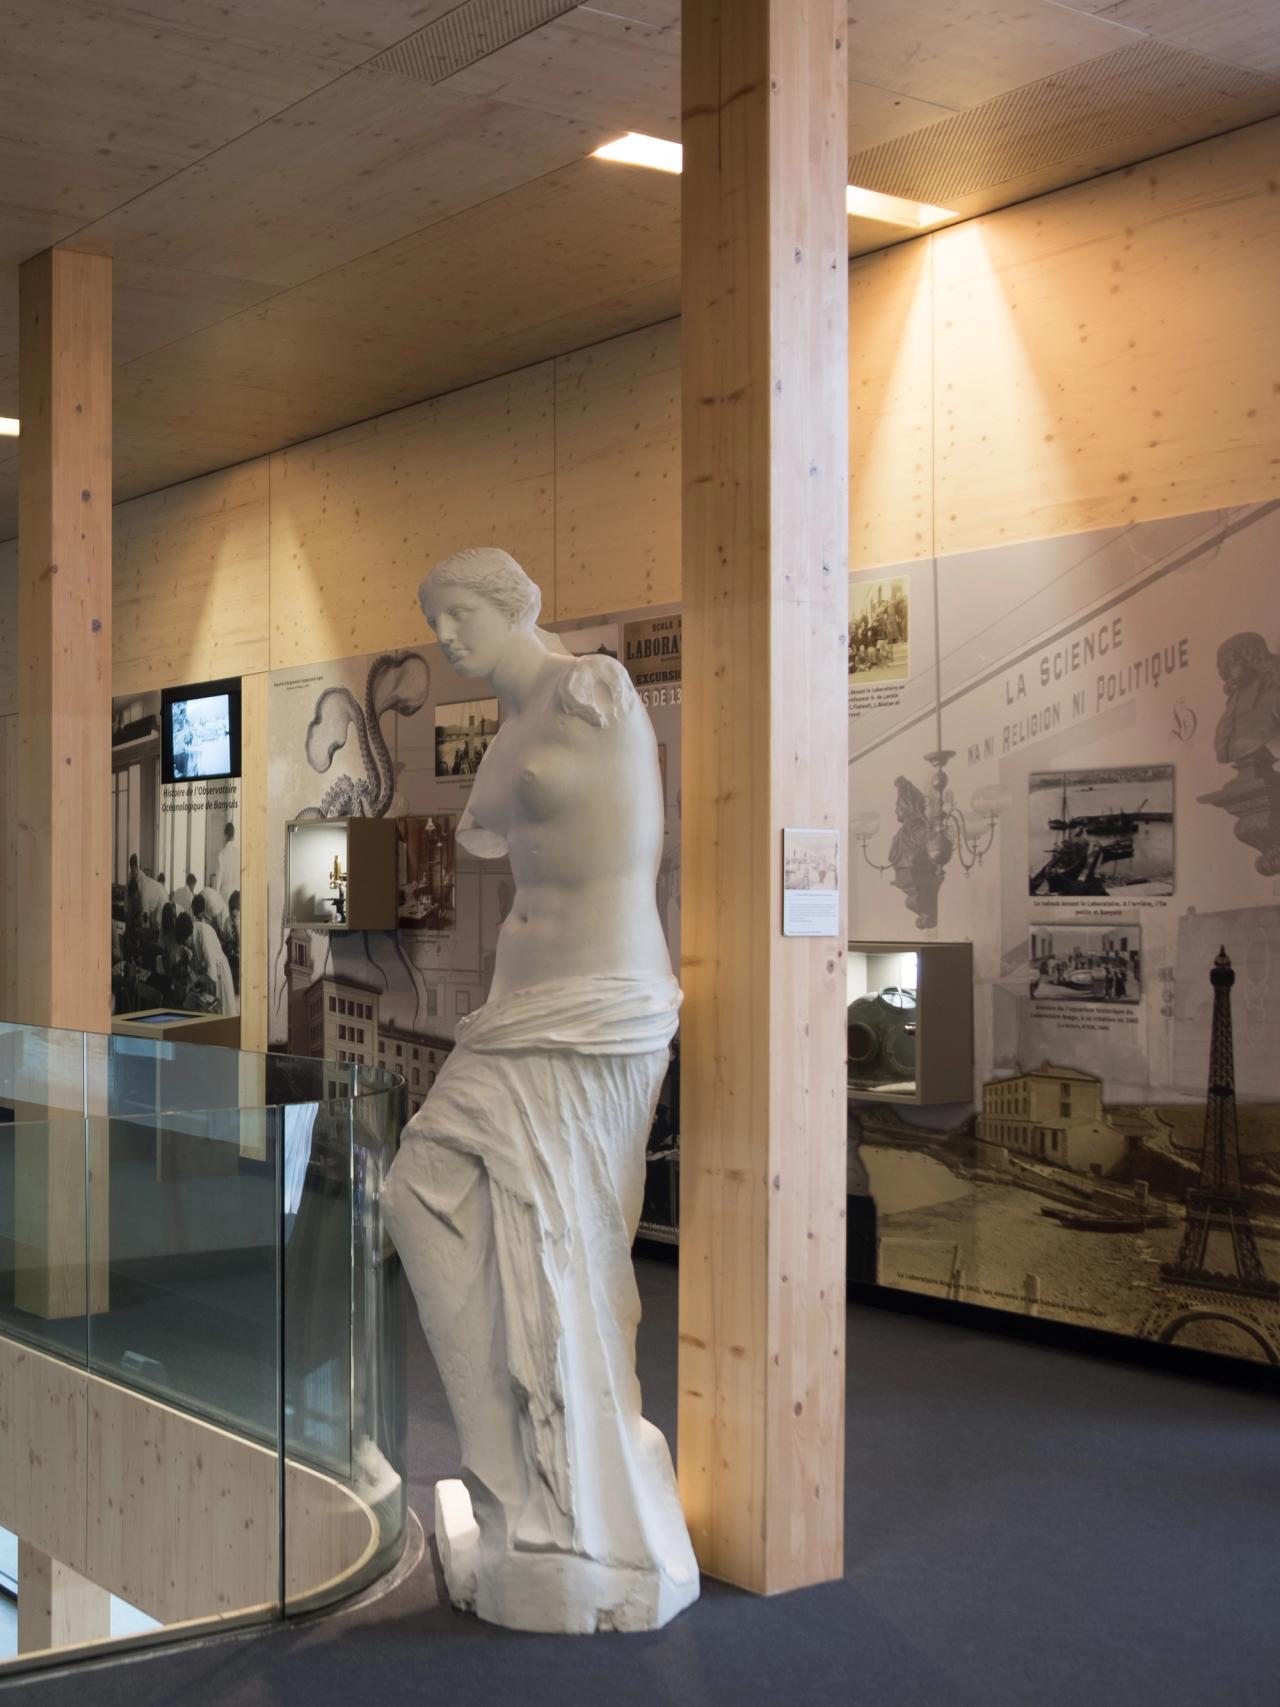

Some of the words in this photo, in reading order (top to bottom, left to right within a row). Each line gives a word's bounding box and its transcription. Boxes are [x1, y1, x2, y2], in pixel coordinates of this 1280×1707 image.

[626, 634, 681, 660] LABORA
[1006, 673, 1027, 705] LA
[1040, 617, 1123, 687] SCIENCE
[653, 689, 667, 706] DE
[1003, 702, 1061, 754] RELIGION
[1073, 690, 1086, 718] NI
[1096, 637, 1189, 713] POLITIQUE
[163, 788, 186, 798] Histoire
[186, 786, 194, 797] de
[194, 784, 238, 796] l'Observatoire
[205, 800, 214, 810] de
[214, 800, 238, 811] Banyuls
